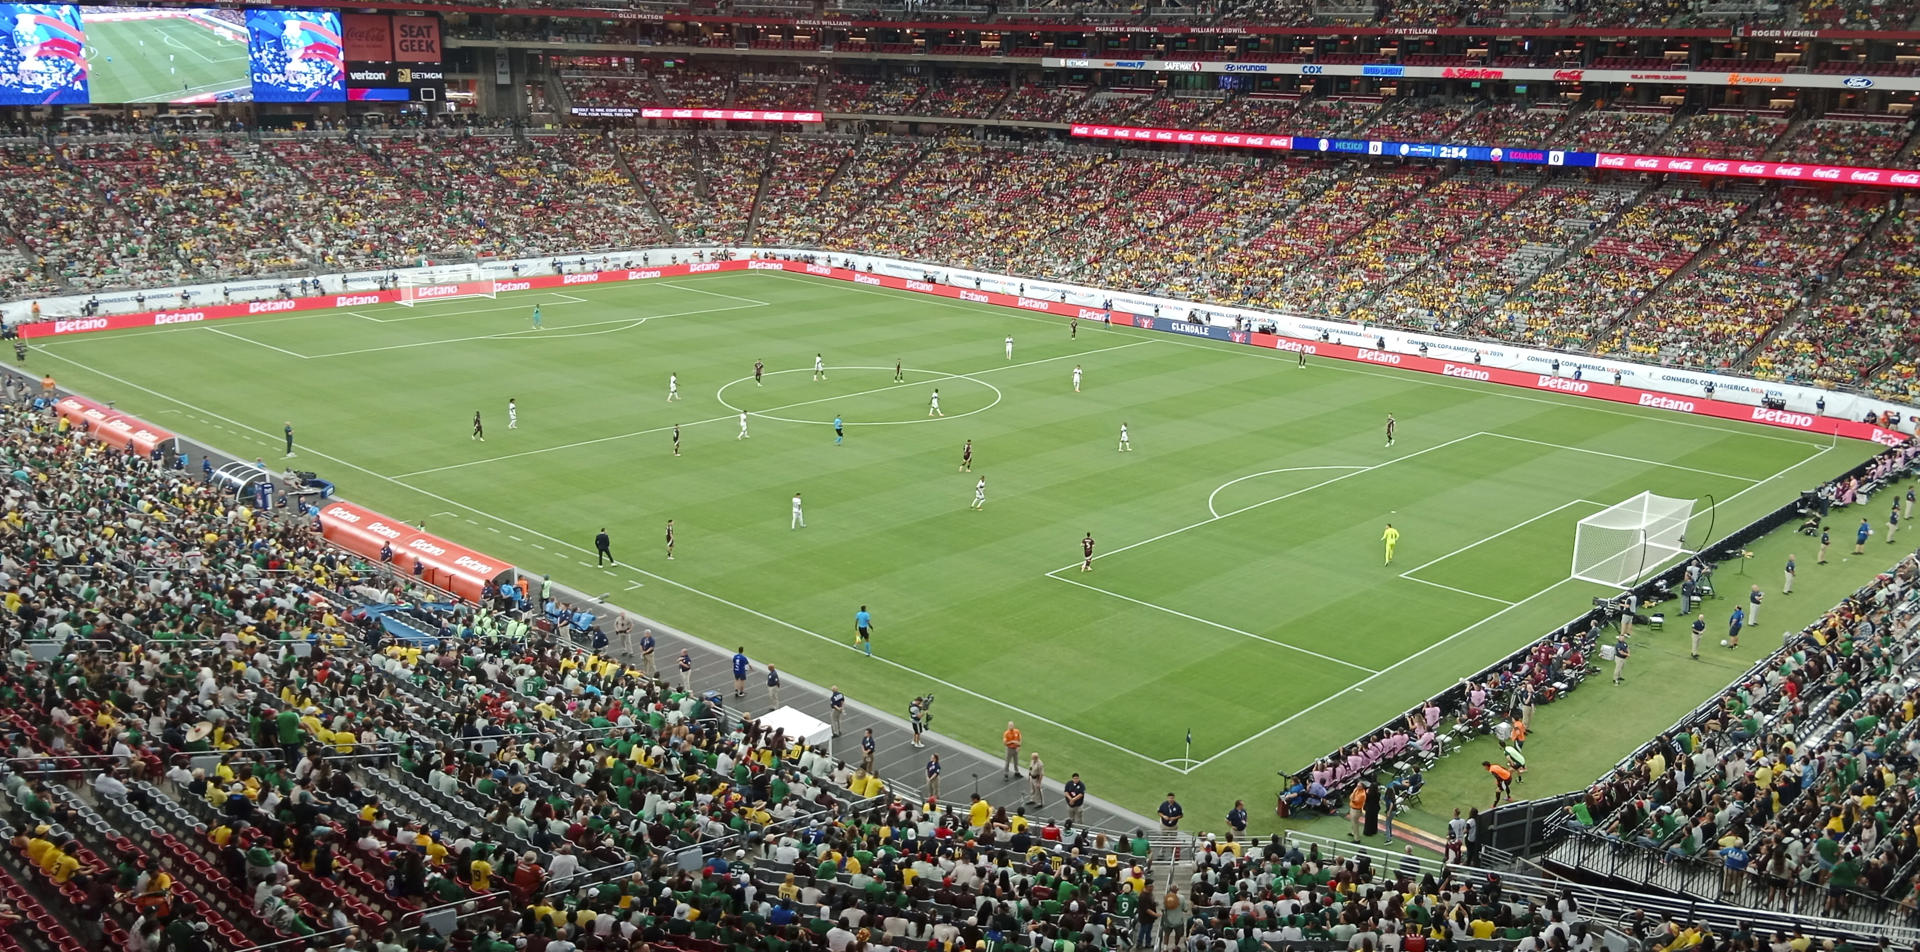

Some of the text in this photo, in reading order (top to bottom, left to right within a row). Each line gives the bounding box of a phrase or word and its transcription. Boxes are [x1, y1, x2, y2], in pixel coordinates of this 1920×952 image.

[400, 24, 432, 39] SEAT
[400, 40, 435, 53] GEEK
[1164, 62, 1193, 70] SAFEWAY
[1302, 65, 1322, 74] COX
[350, 70, 386, 80] verizon
[411, 72, 442, 80] BETMGM
[1335, 141, 1363, 150] MEXICO
[1439, 147, 1467, 158] 2:54
[1509, 151, 1543, 161] ECUADOR
[1553, 155, 1559, 163] 0
[690, 262, 720, 273] Betano
[747, 261, 783, 271] Betano
[806, 263, 831, 275] Betano
[563, 273, 598, 284] Betano
[628, 269, 661, 279] Betano
[854, 274, 880, 286] Betano
[418, 284, 458, 297] Betano
[495, 281, 530, 293] Betano
[906, 279, 933, 292] Betano
[335, 295, 379, 307] Betano
[960, 290, 989, 303] Betano
[249, 300, 295, 313] Betano
[1017, 297, 1048, 310] Betano
[154, 311, 204, 325] Betano
[1078, 308, 1106, 322] Betan
[54, 318, 107, 332] Betano
[1171, 322, 1209, 336] GLENDALE
[1276, 339, 1316, 354] Betano
[1437, 343, 1452, 351] COPA
[1453, 346, 1477, 354] AMERICA
[1357, 348, 1400, 364] Betano
[1561, 360, 1578, 368] COPA
[1579, 363, 1606, 372] AMERICA
[1443, 364, 1489, 382] Betano
[1538, 376, 1588, 393] Betano
[1661, 375, 1699, 385] CONMEBOL
[1718, 383, 1750, 392] AMERICA
[1639, 392, 1694, 413] Betano
[1752, 407, 1813, 428] Betano
[1121, 901, 1129, 913] 9
